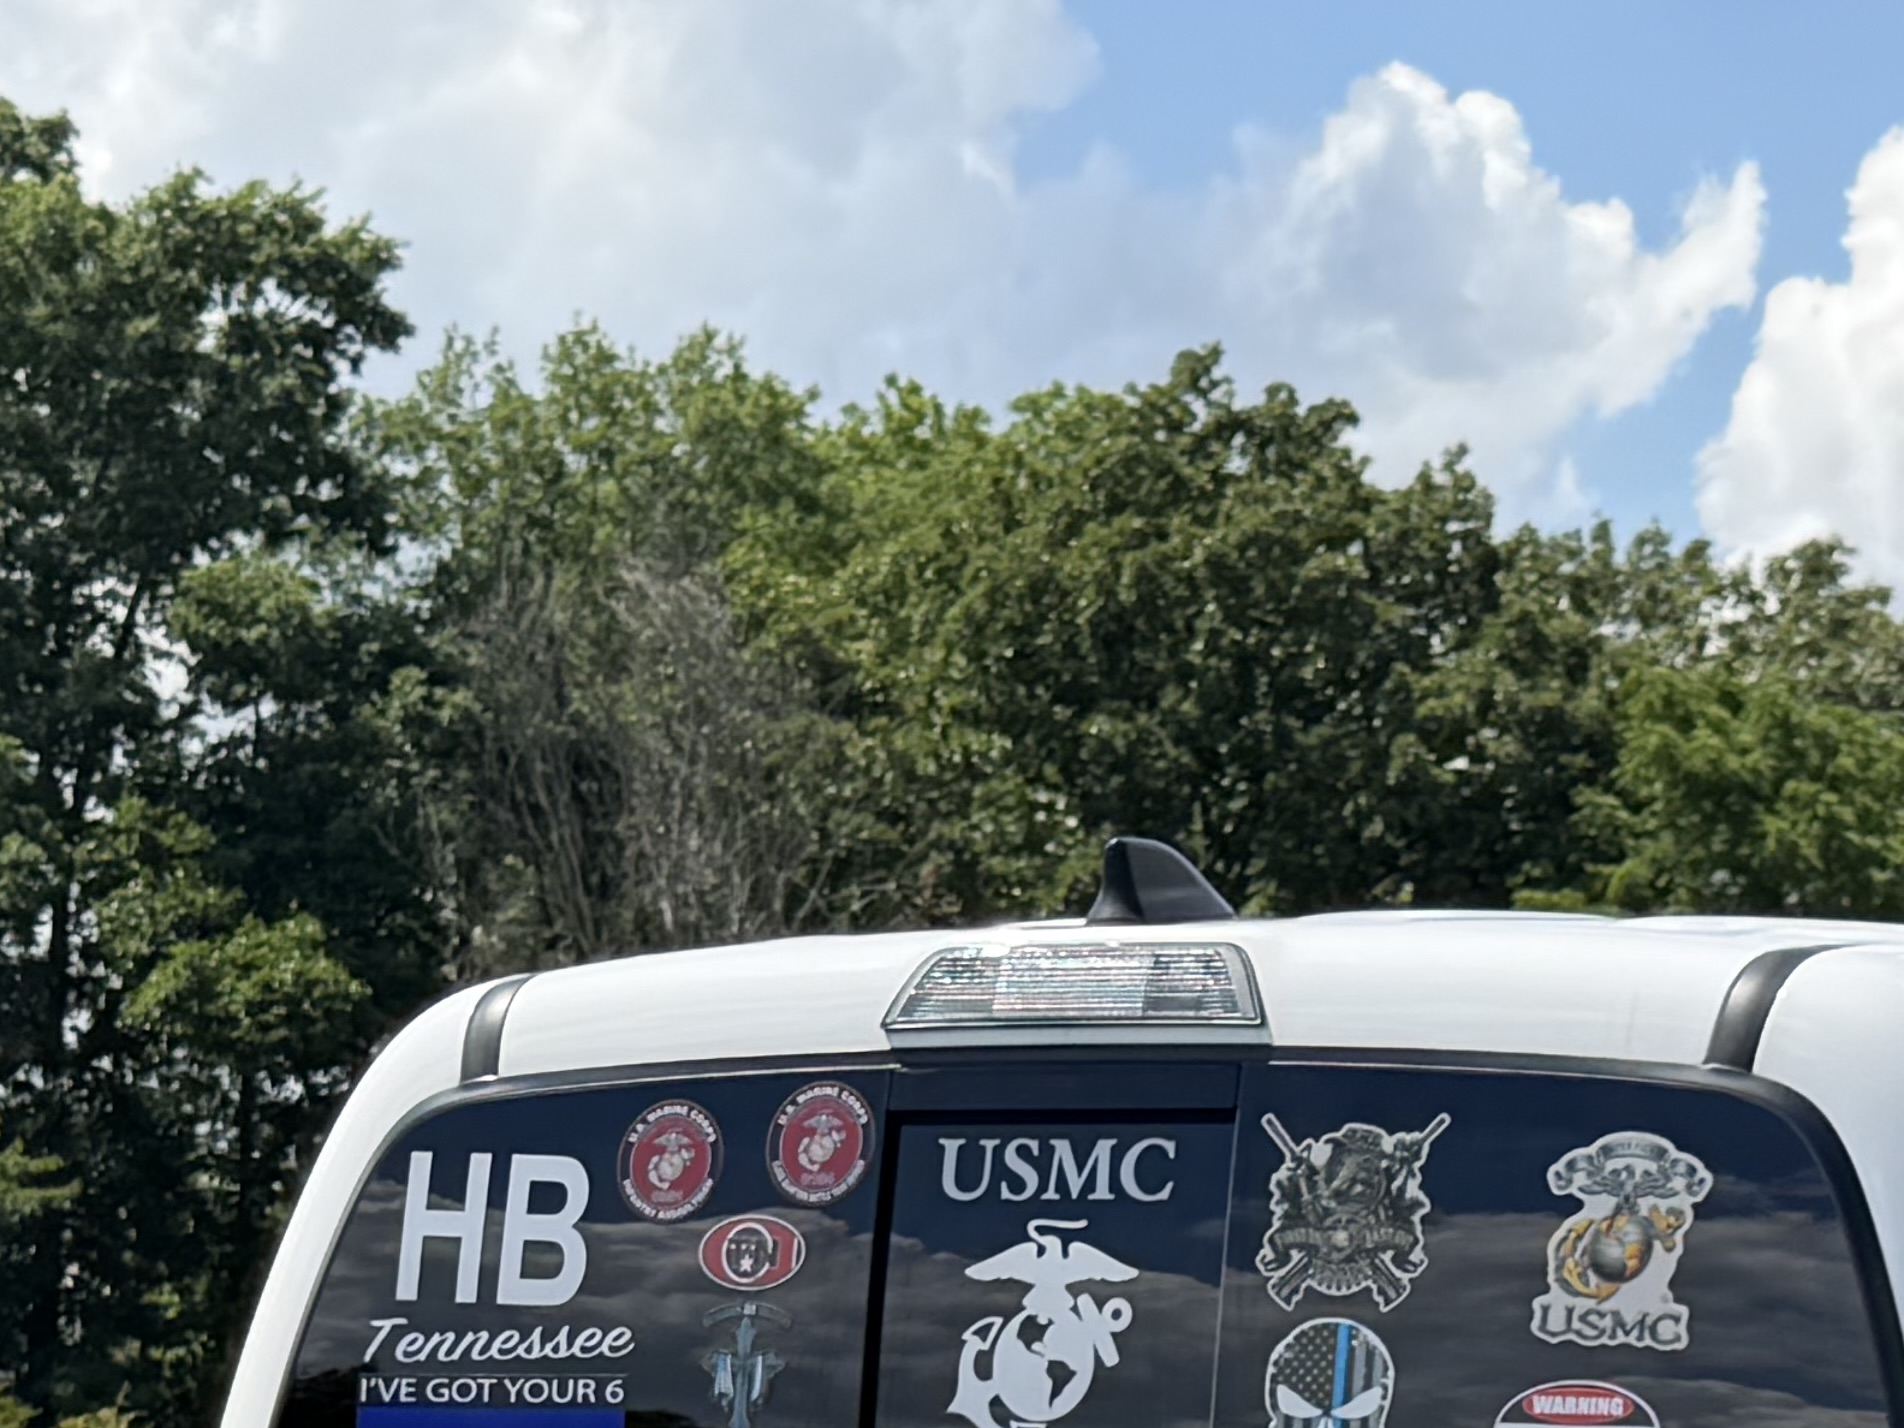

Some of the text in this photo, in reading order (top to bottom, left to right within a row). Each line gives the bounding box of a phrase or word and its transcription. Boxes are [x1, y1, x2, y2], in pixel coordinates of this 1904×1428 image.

[938, 1137, 1177, 1202] USMC
[396, 1151, 590, 1306] HB
[363, 1317, 635, 1363] Tennessee
[1539, 1303, 1682, 1345] USMC
[360, 1378, 625, 1404] I'VE GOT YOUR 6
[1532, 1395, 1624, 1416] WARNING
